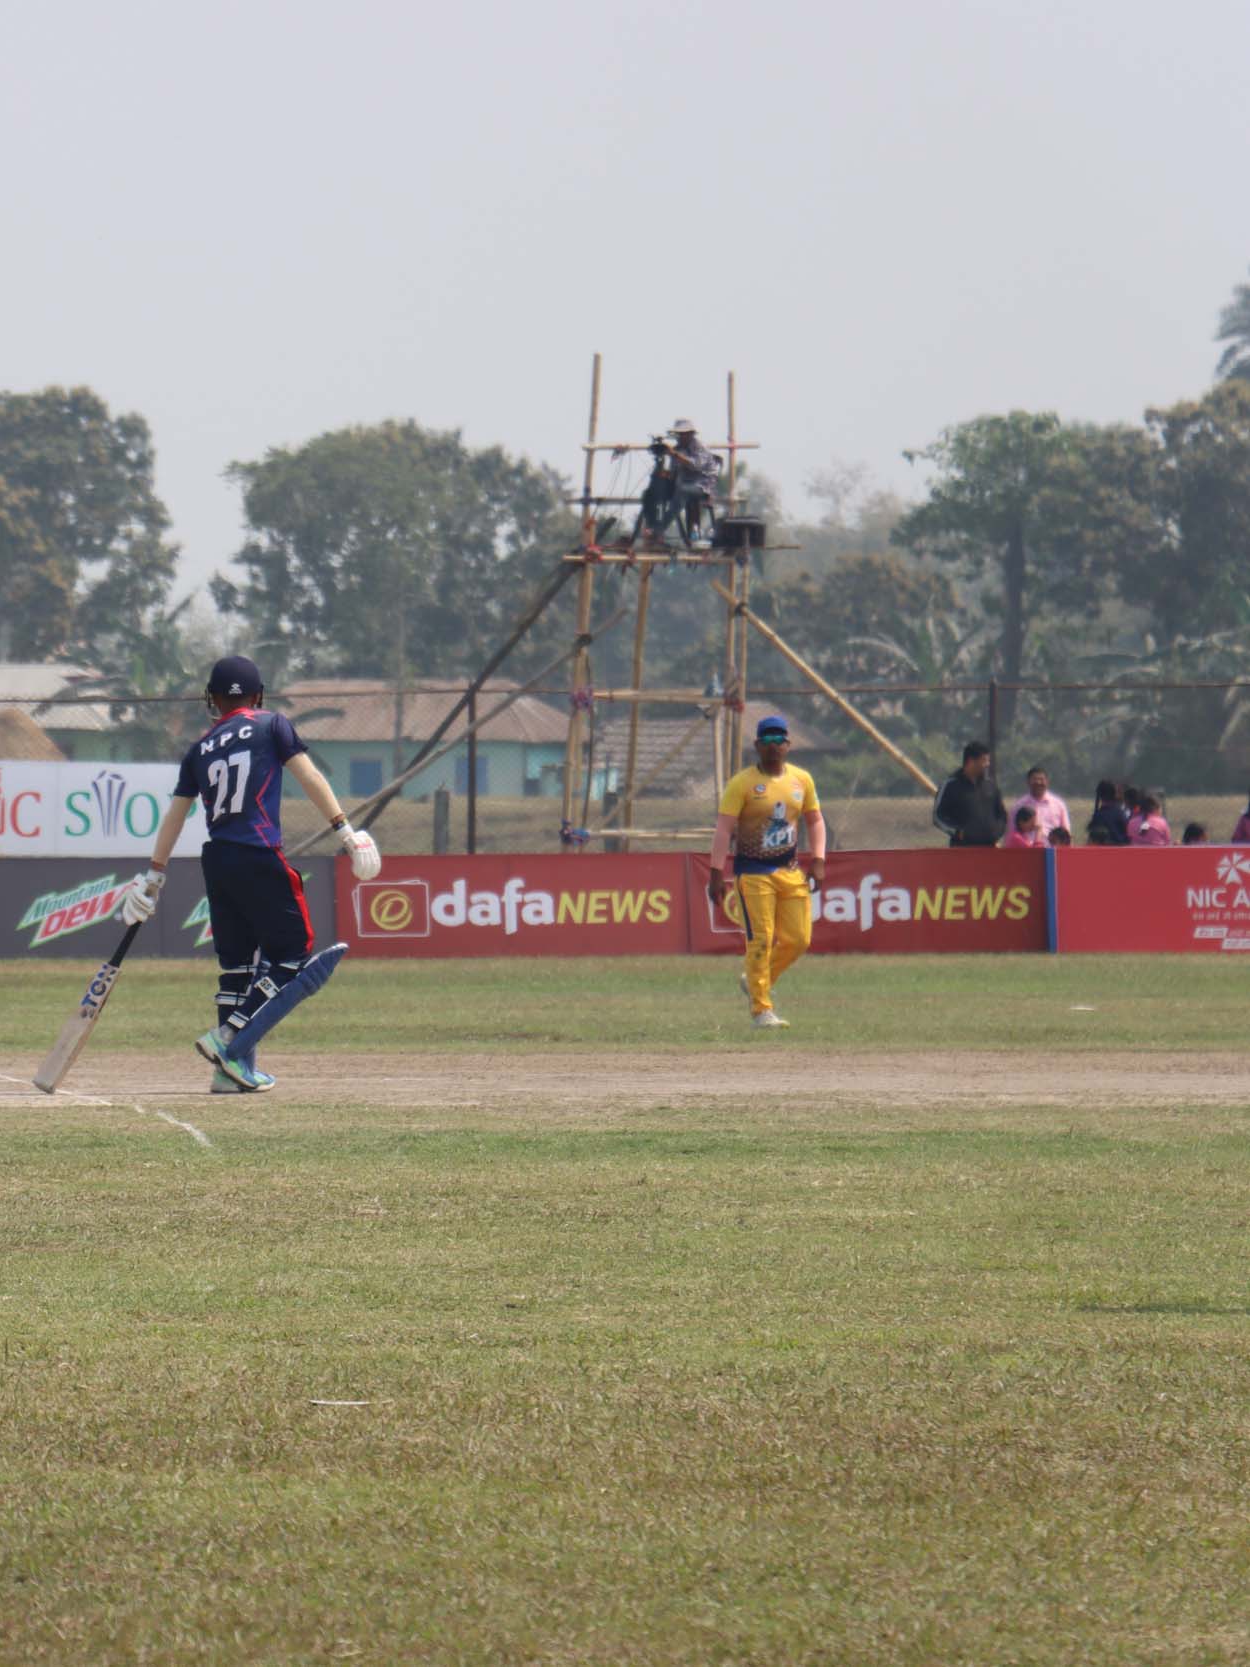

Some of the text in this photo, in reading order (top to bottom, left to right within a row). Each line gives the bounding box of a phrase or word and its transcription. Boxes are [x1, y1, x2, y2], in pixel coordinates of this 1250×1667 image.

[200, 725, 253, 755] NPC
[207, 750, 251, 822] 27
[761, 824, 794, 848] KPT
[810, 873, 1031, 933] afaNEWS
[1186, 886, 1227, 909] NIC
